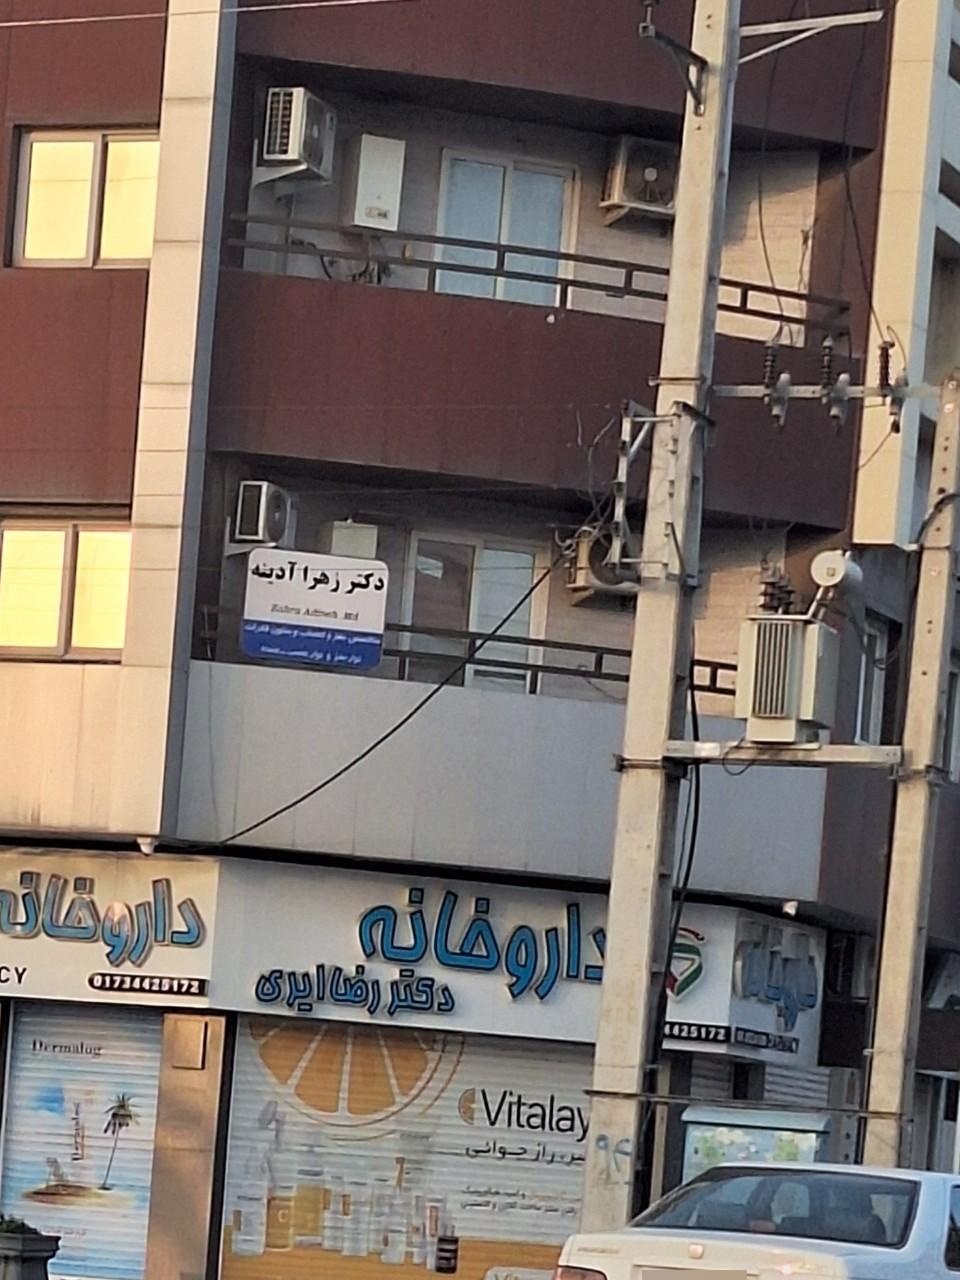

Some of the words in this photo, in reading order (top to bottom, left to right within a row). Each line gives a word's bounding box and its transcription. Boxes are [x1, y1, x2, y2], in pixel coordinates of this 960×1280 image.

[251, 562, 297, 585] آدینه
[303, 565, 341, 593] زهرا
[345, 572, 385, 593] دکتر
[255, 964, 326, 1013] ایری
[329, 964, 381, 1016] رضا
[386, 968, 455, 1016] دکتر
